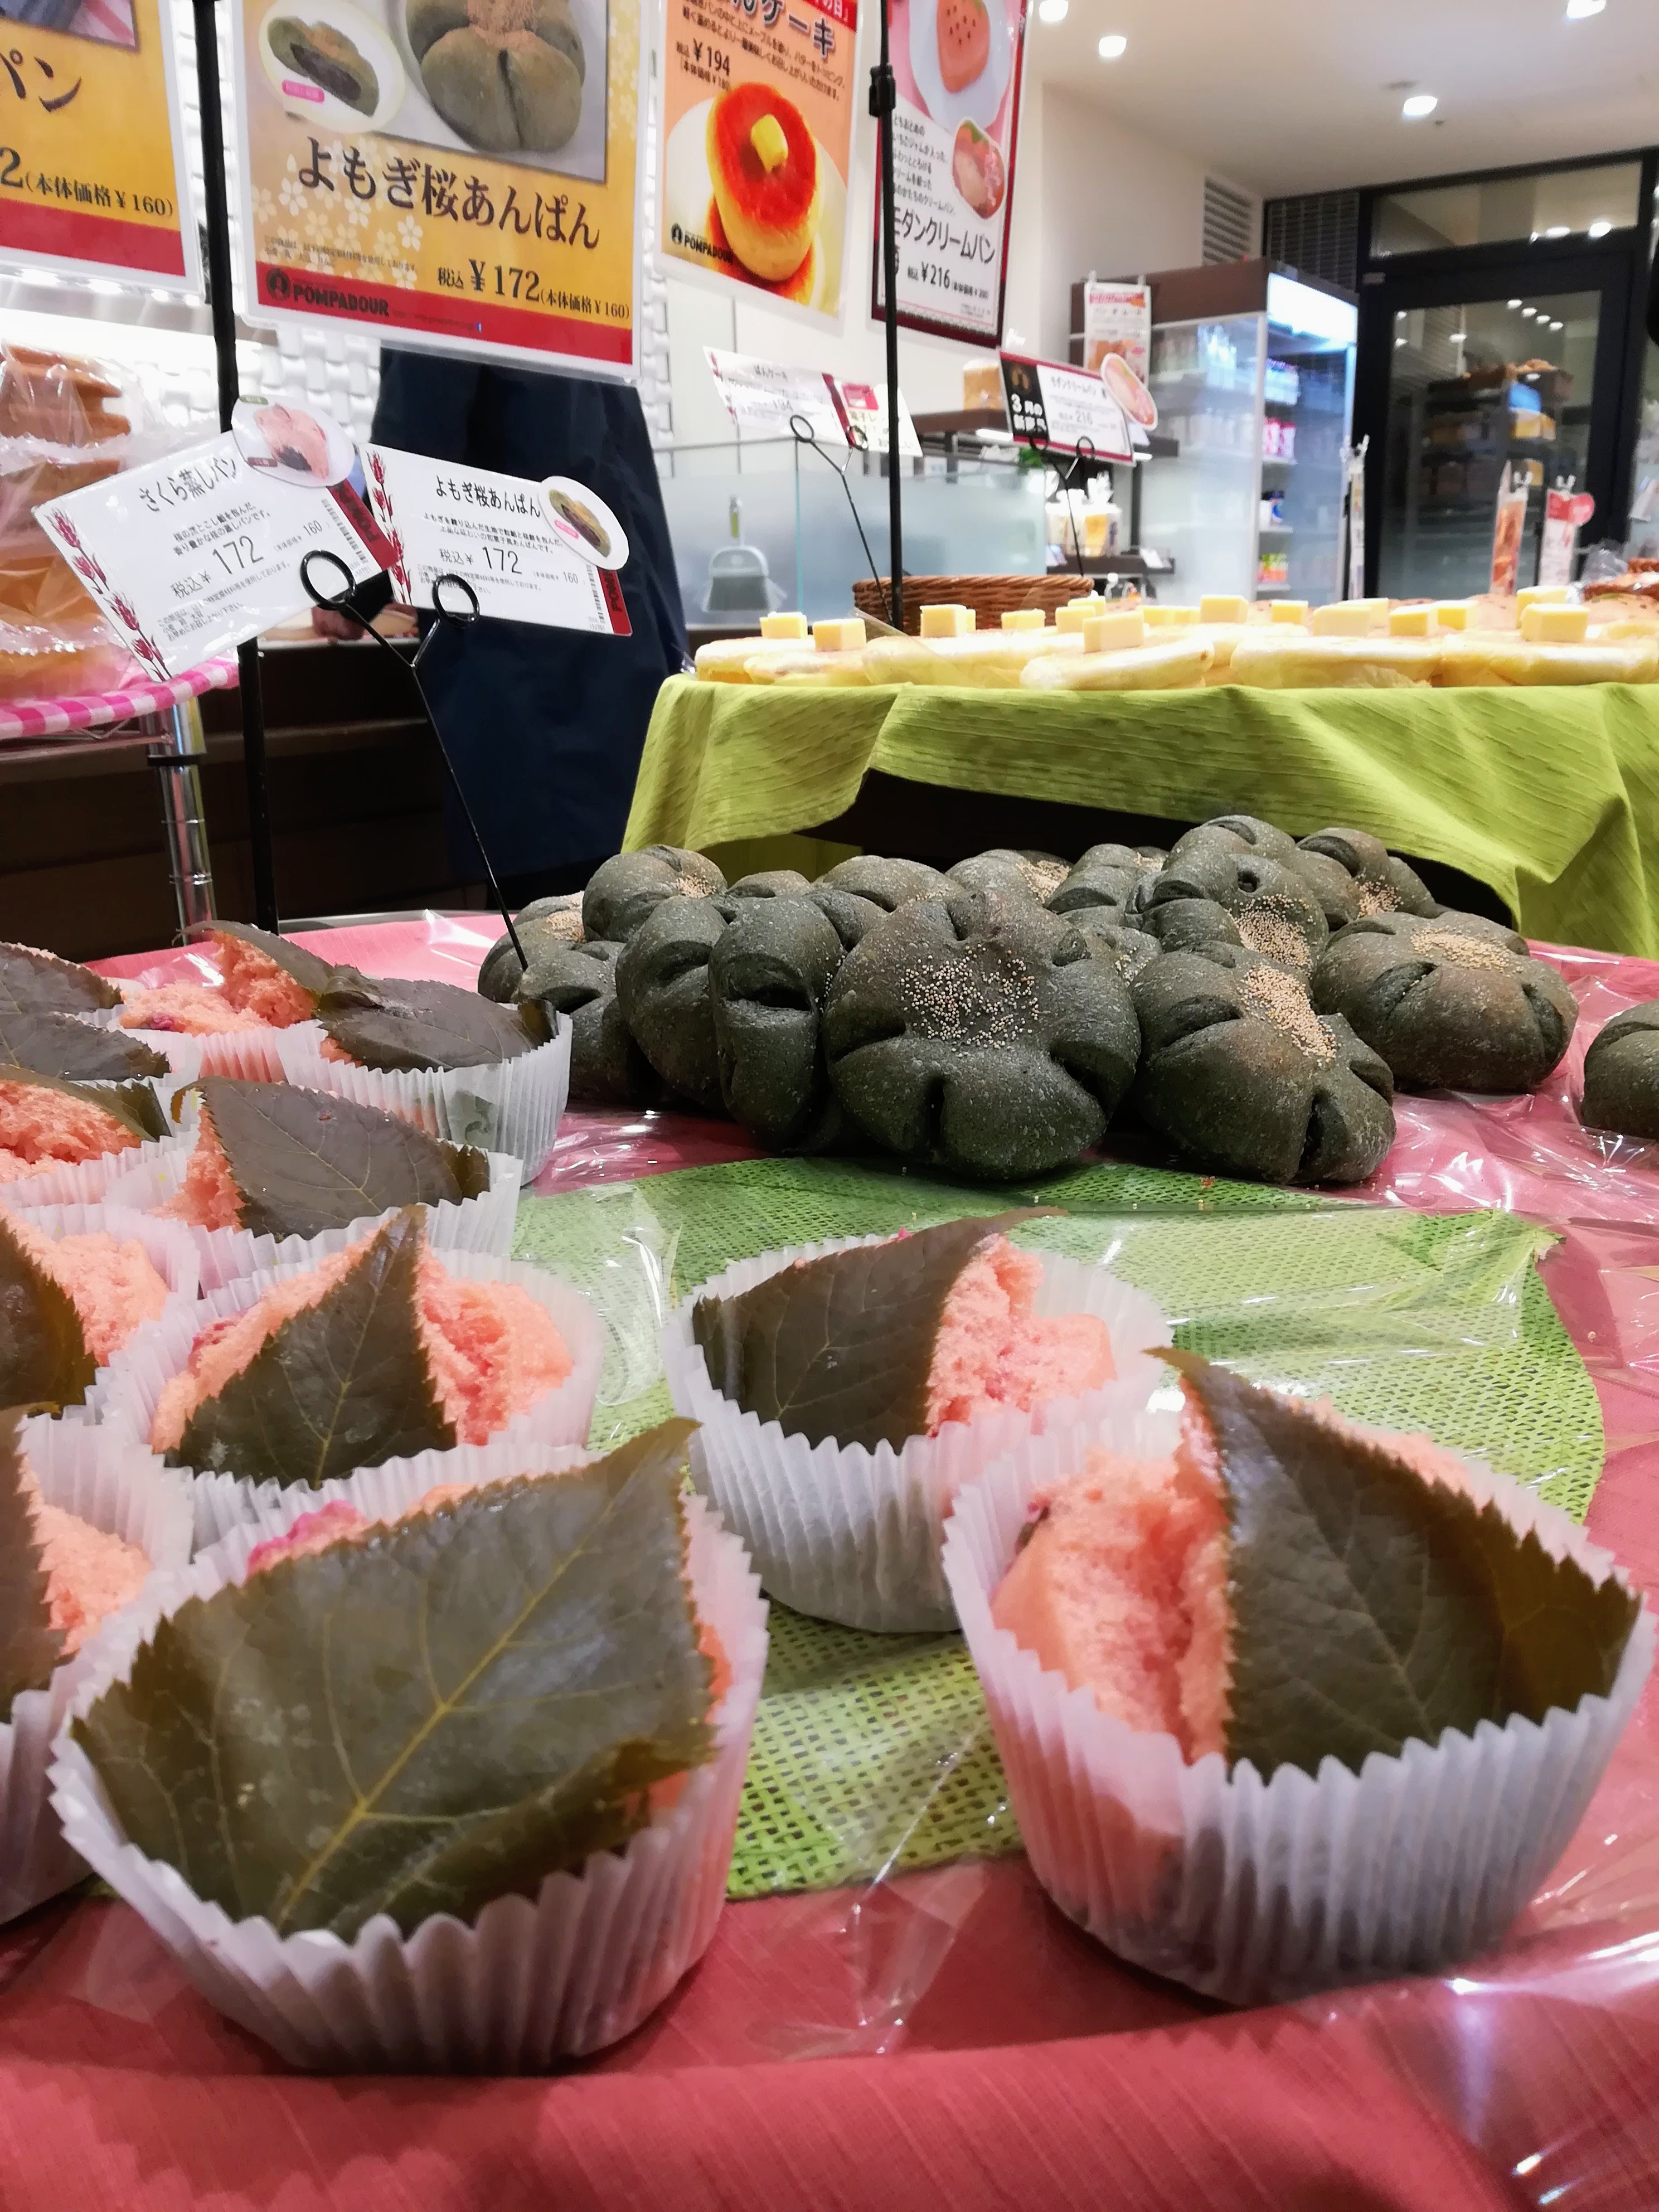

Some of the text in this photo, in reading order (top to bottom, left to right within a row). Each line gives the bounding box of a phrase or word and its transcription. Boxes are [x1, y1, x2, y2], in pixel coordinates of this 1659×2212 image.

[298, 136, 600, 250] よもぎ桜あんぱん
[292, 283, 389, 317] POMPADOUR
[139, 457, 237, 512] さくら蒸しパン
[436, 475, 541, 518] よもぎ桜あんぱん
[212, 535, 264, 575] 172
[482, 546, 522, 575] 172
